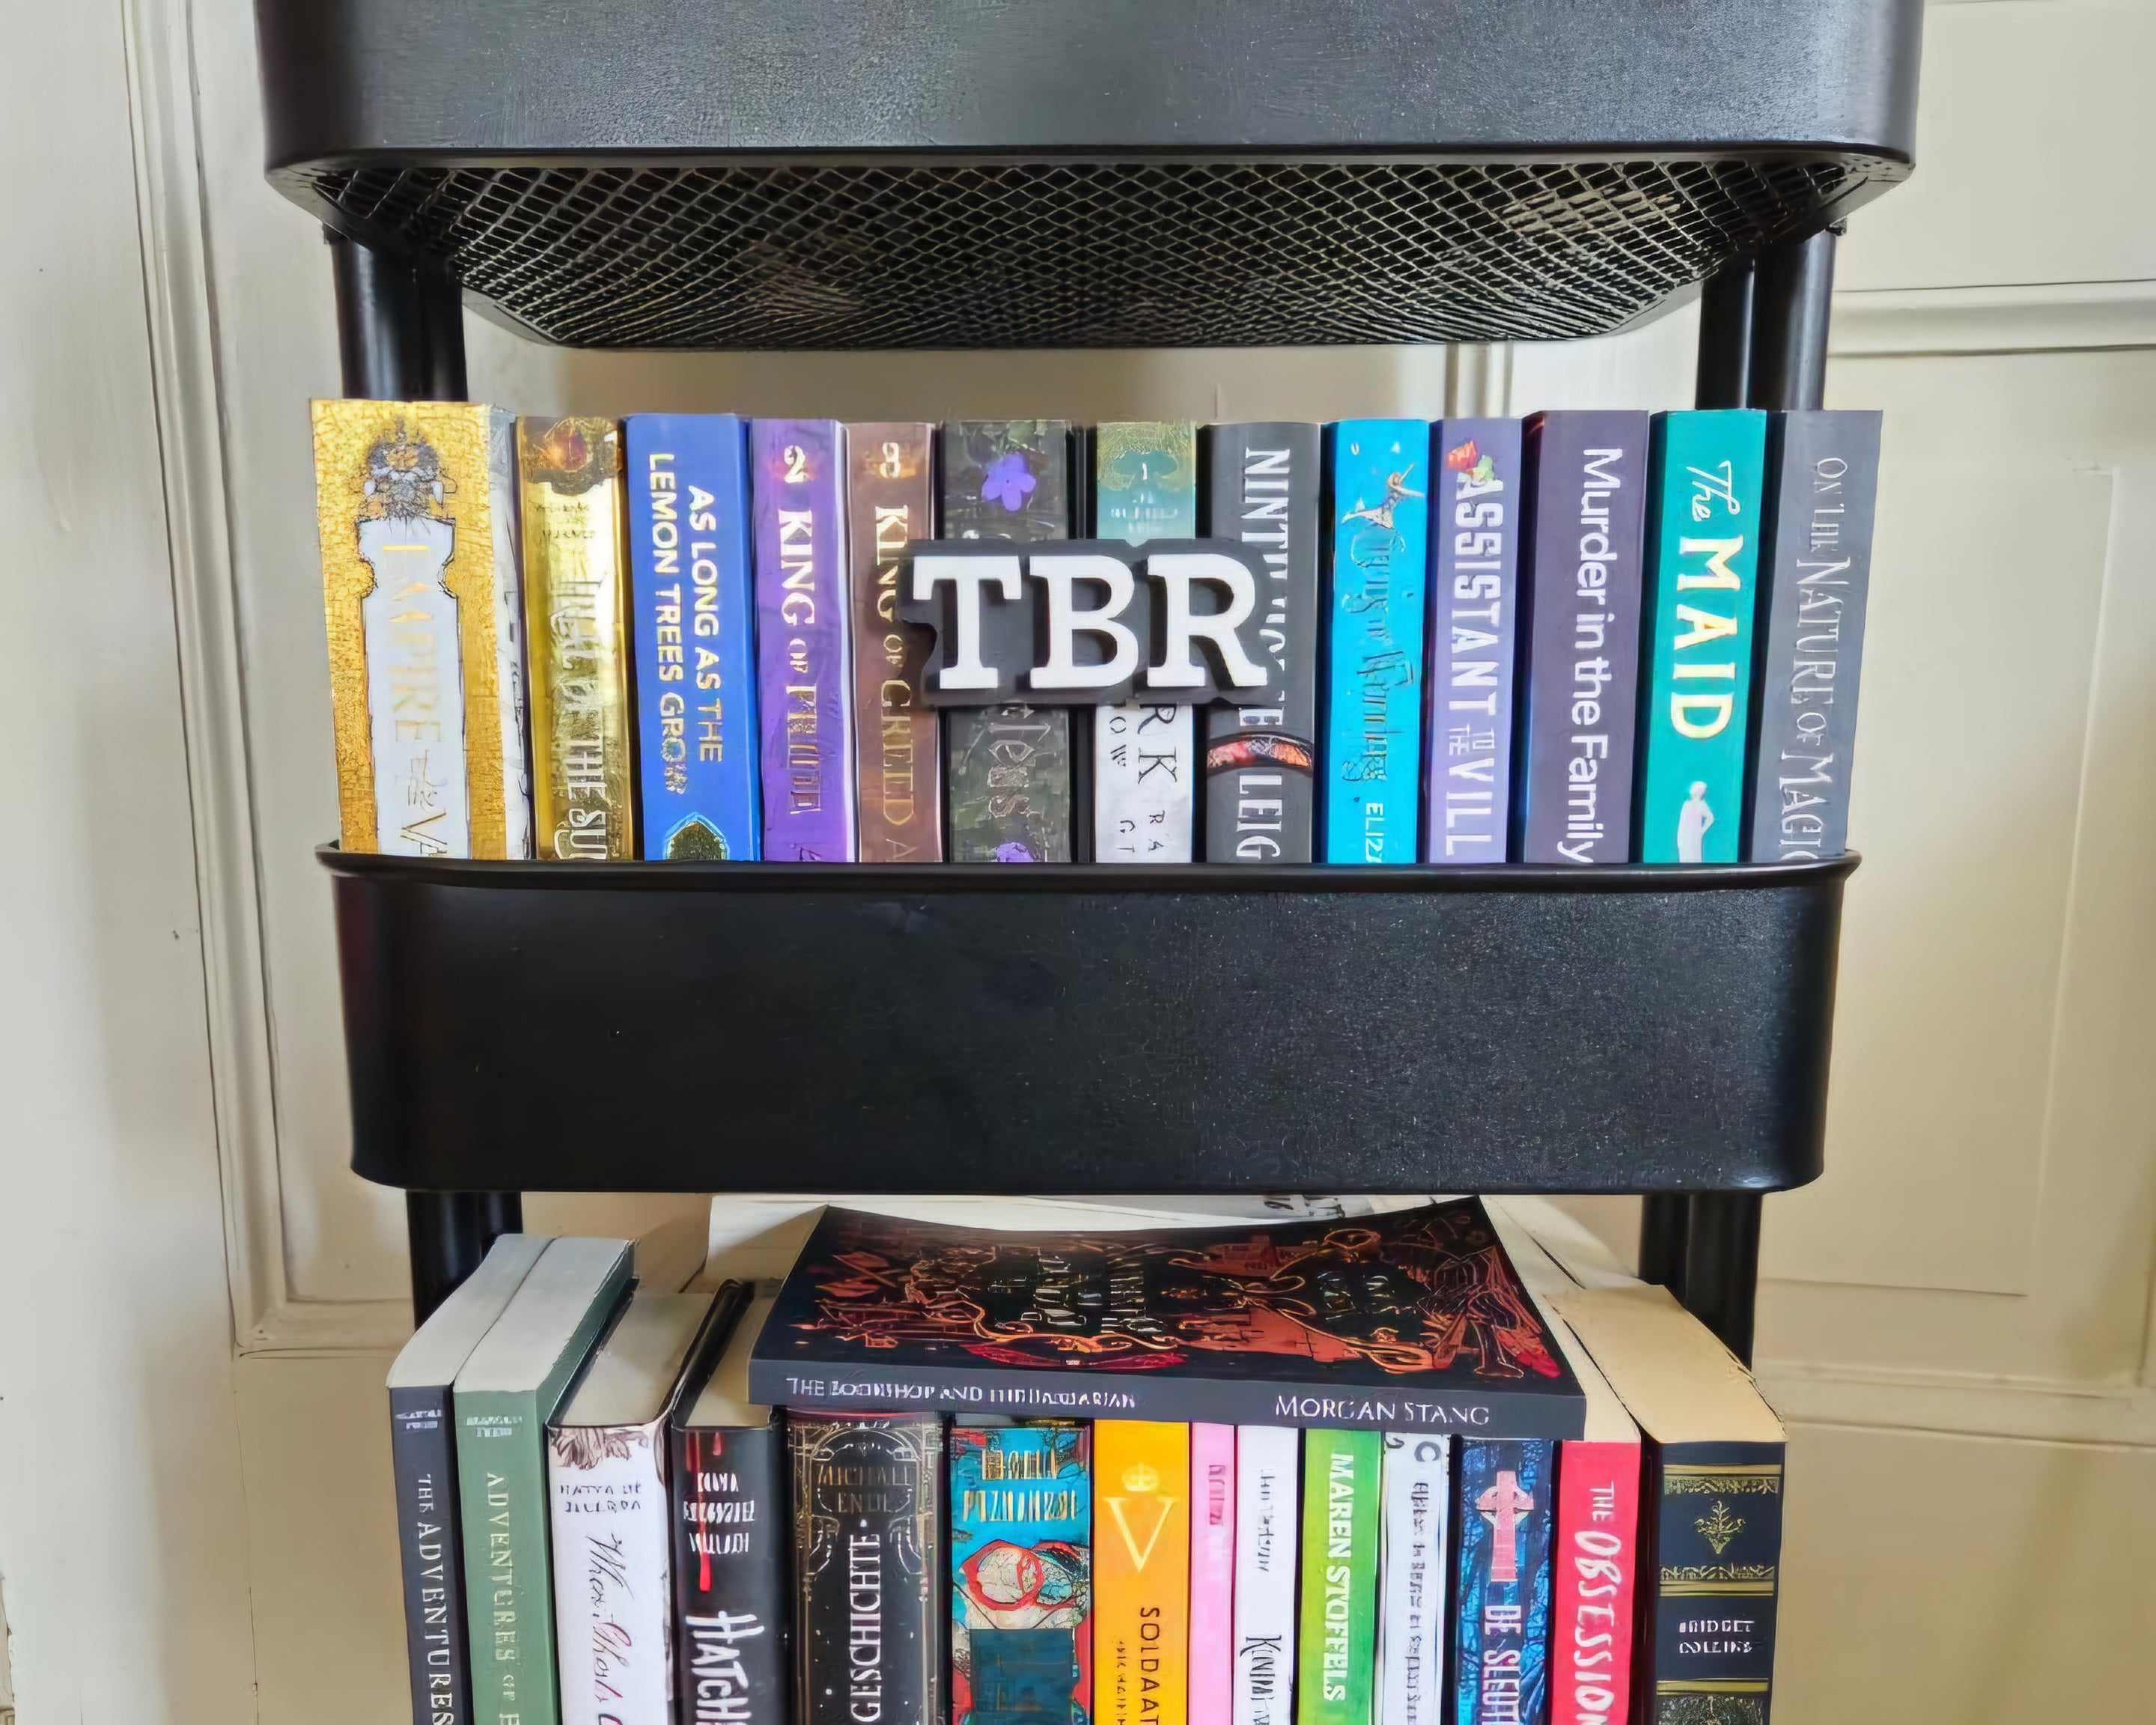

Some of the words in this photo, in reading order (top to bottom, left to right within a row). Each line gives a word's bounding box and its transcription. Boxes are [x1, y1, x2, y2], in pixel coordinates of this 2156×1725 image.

[784, 445, 808, 484] 2
[1685, 459, 1742, 523] The
[648, 453, 680, 574] LEMON
[689, 485, 716, 531] AS
[1574, 447, 1624, 603] Murder
[689, 541, 719, 637] LONG
[777, 508, 816, 627] KING
[1449, 478, 1504, 717] ASSISTANT
[654, 586, 685, 682] TREES
[787, 638, 809, 674] OF
[913, 553, 1269, 690] TBR
[1575, 612, 1616, 651] in
[1669, 533, 1745, 740] MAID
[1790, 556, 1852, 706] NATURE
[695, 646, 722, 690] AS
[1571, 656, 1613, 726] the
[697, 699, 722, 763] THE
[1448, 723, 1473, 756] THE
[1472, 728, 1496, 751] TO
[554, 807, 606, 860] SU
[1556, 733, 1609, 864] Family
[786, 1376, 825, 1397] THE
[1275, 1395, 1396, 1421] MORGAN
[416, 1472, 435, 1514] THE
[1327, 1452, 1355, 1558] MAREN
[1589, 1480, 1616, 1523] THE
[486, 1471, 517, 1662] ADVENTURES
[1103, 1497, 1178, 1572] V
[416, 1521, 455, 1725] ADVENTURES
[849, 1533, 883, 1722] GESCHICHTE
[1322, 1565, 1351, 1702] STOFFELS
[1484, 1604, 1522, 1636] DE
[685, 1610, 765, 1725] HATCH
[1482, 1649, 1521, 1725] SLEUT
